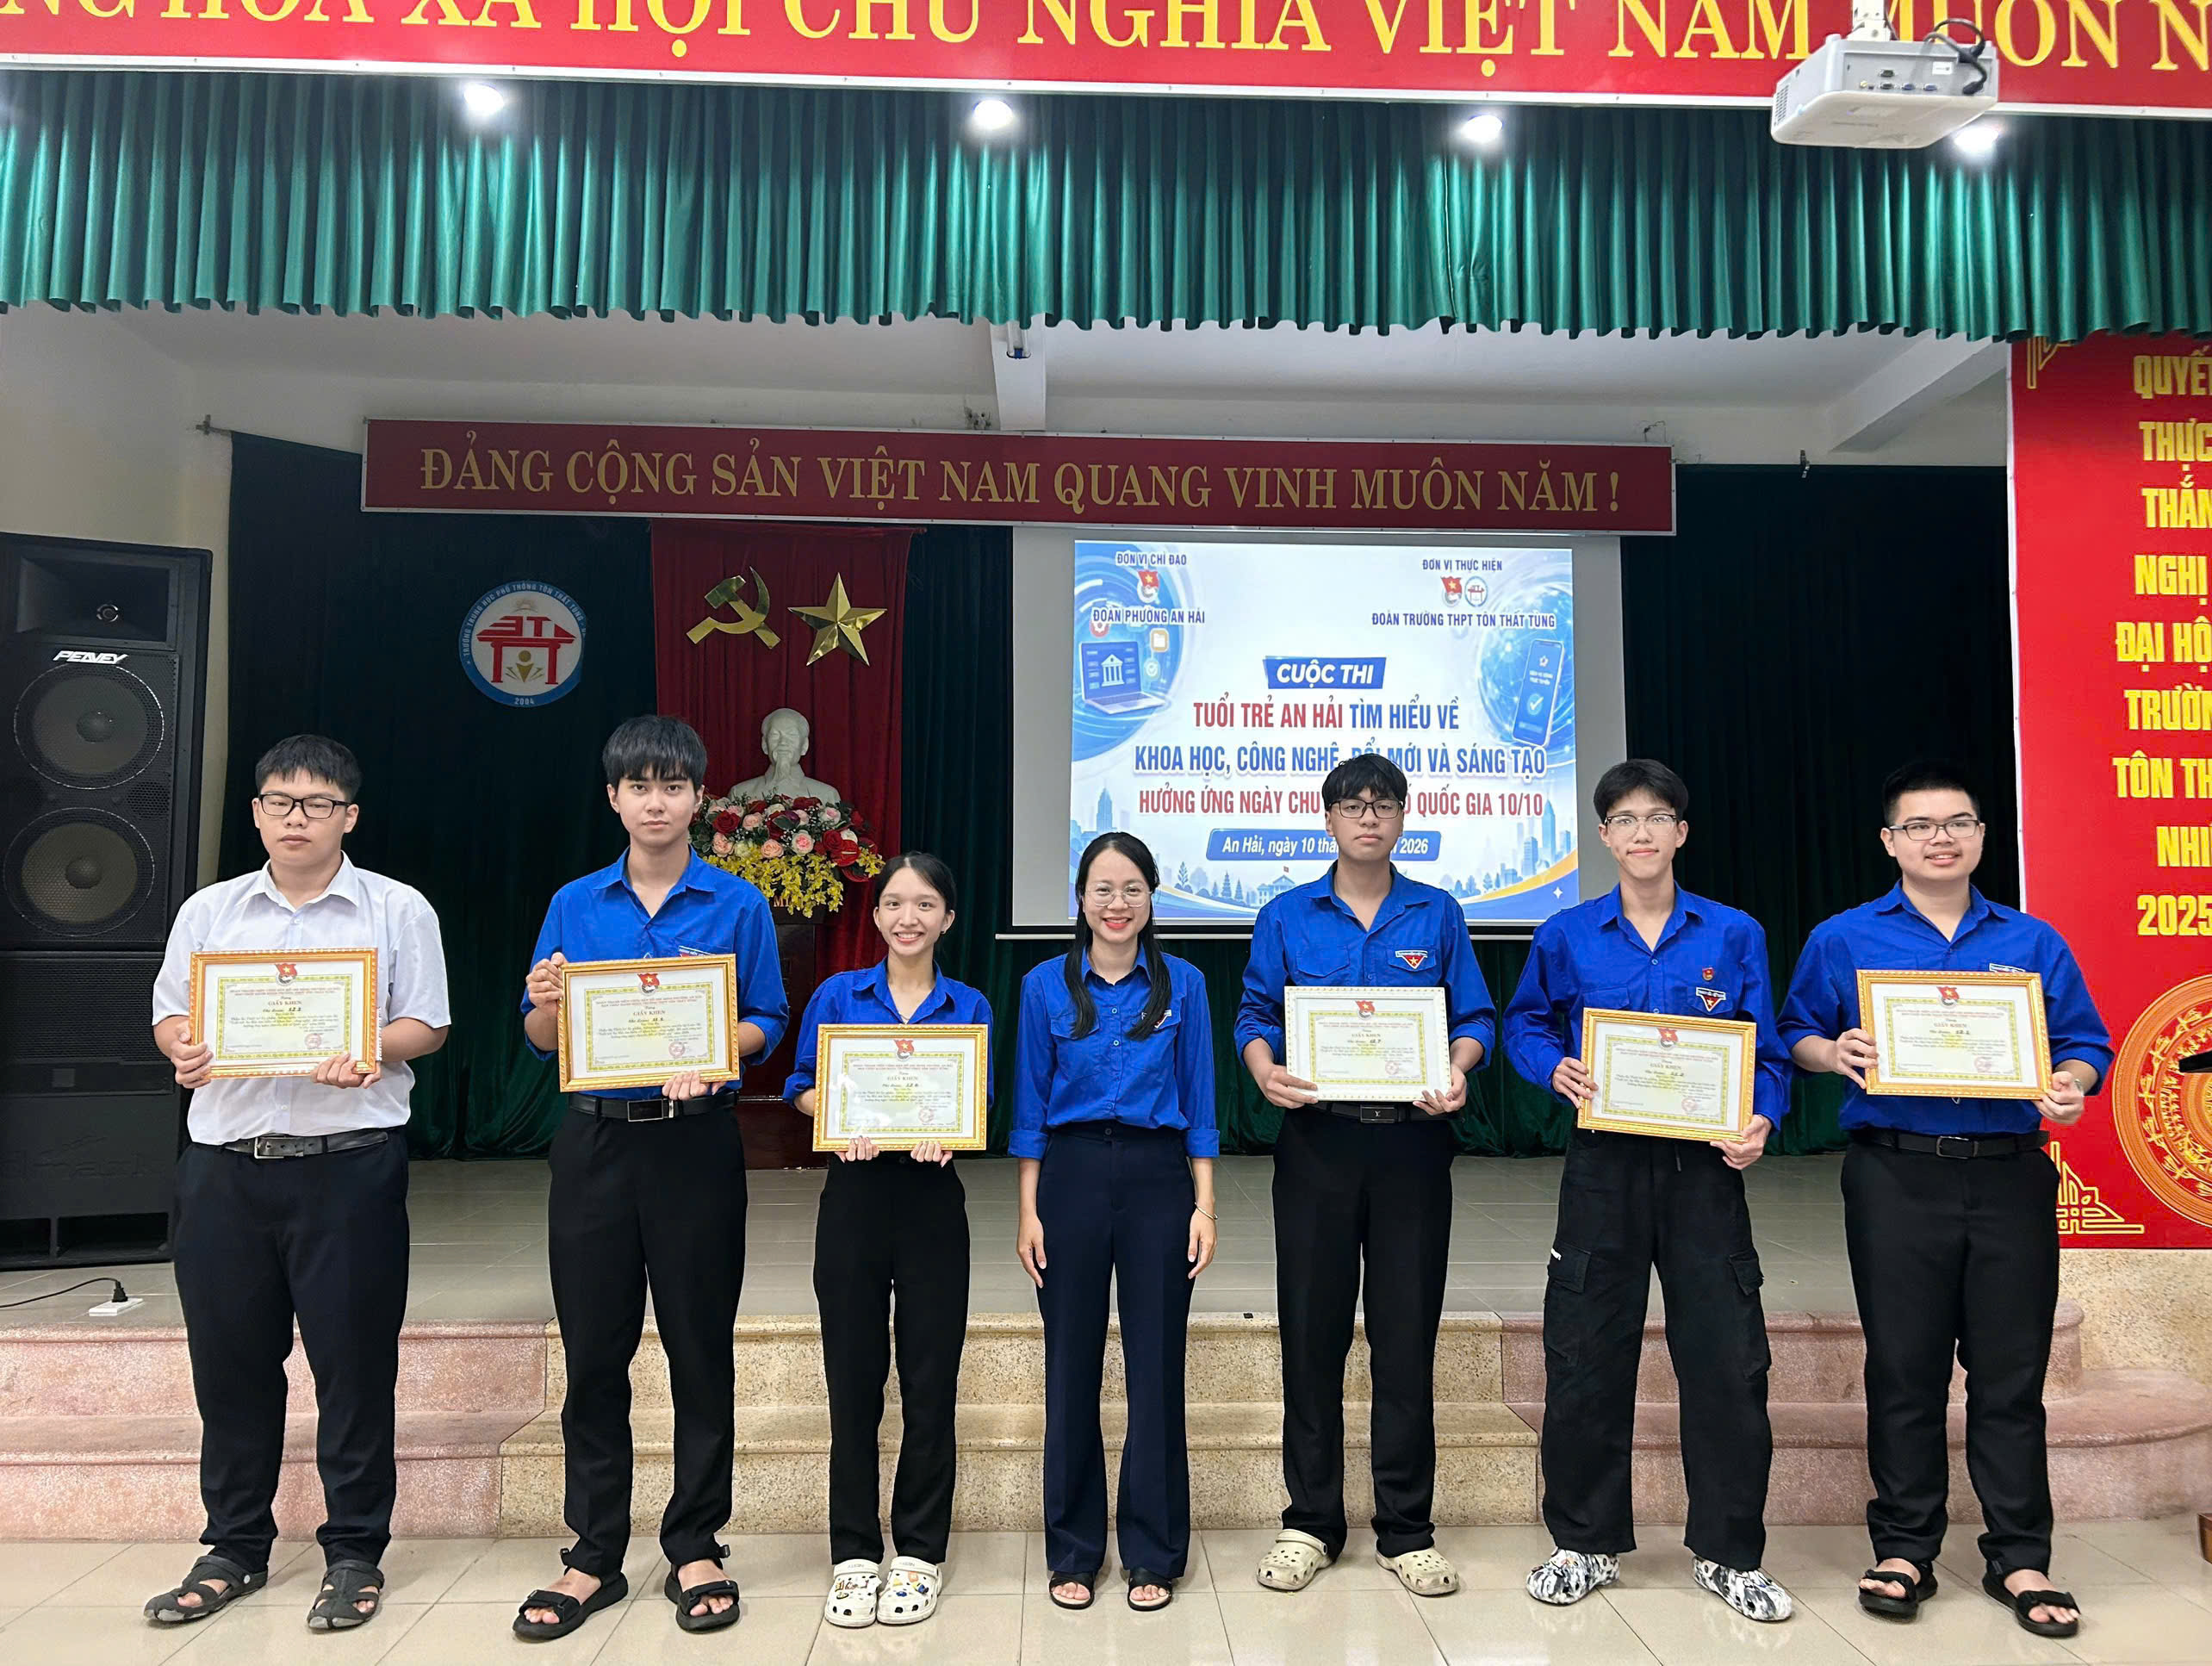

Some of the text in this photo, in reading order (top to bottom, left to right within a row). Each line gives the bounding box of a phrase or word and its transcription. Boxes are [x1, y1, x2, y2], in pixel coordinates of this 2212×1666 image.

[1607, 0, 1811, 59] NAM
[2133, 345, 2212, 399] QUYẾ
[420, 430, 552, 494] ĐẢNG
[565, 439, 697, 505] CỘNG
[711, 437, 802, 498] SẢN
[817, 444, 926, 511] VIỆT
[938, 460, 1041, 503] NAM
[1053, 463, 1212, 514] QUANG
[1223, 468, 1337, 509] VINH
[1351, 457, 1484, 511] MUÔN
[1497, 459, 1598, 512] NĂM
[2134, 555, 2209, 605] NGHỊ
[1125, 606, 1167, 623] PHƯỜNG
[1171, 611, 1184, 623] AN
[1447, 614, 1473, 626] THPT
[53, 650, 129, 664] PEAVEY
[2116, 622, 2165, 672] ĐẠI
[1277, 659, 1375, 688] CUỘC THI
[1193, 692, 1459, 729] TUỔI TRẺ AN HẢI TÌM HIỂU VỀ
[1134, 745, 1184, 771] KHOA
[1190, 745, 1231, 776] HỌC,
[1237, 741, 1286, 772] CÔNG
[1428, 743, 1451, 773] VÀ
[1457, 743, 1506, 774] SÁNG
[1511, 748, 1546, 780] TẠO
[2112, 749, 2174, 798] TÔN
[1139, 782, 1195, 814] HƯỞNG
[1201, 785, 1233, 814] ỨNG
[1240, 786, 1283, 814] NGÀY
[1417, 784, 1460, 817] QUỐC
[1466, 792, 1493, 816] GIA
[1498, 793, 1544, 817] 10/10
[1222, 836, 1240, 854] An
[1242, 834, 1265, 855] Hải,
[1268, 836, 1298, 858] ngày
[1302, 837, 1315, 854] 10
[1399, 837, 1429, 855] 2026
[2156, 825, 2212, 867] NHI
